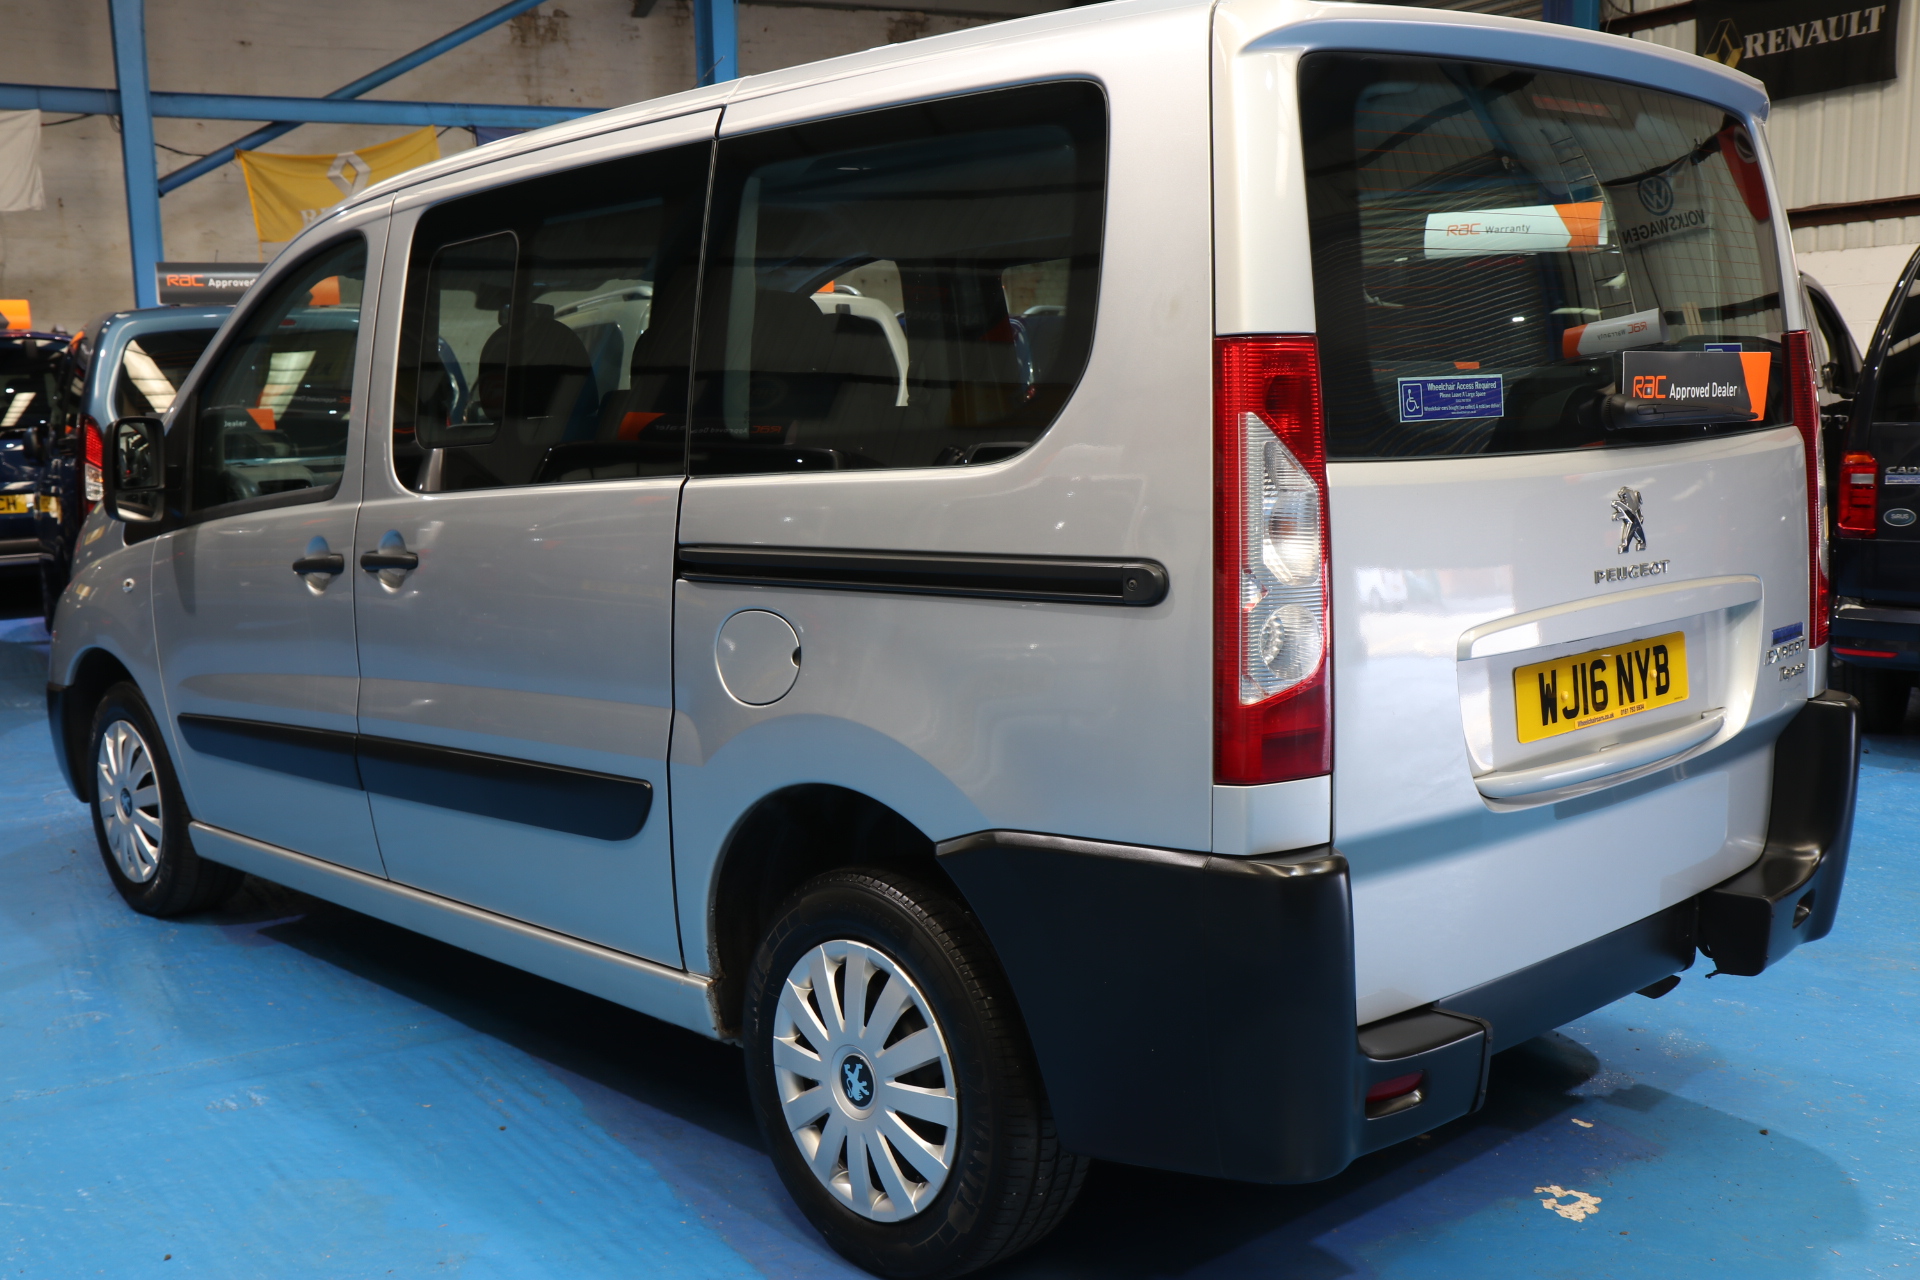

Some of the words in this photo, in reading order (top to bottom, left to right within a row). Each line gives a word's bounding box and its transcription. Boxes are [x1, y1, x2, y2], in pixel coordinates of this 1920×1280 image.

[1743, 5, 1886, 59] RENAULT
[1485, 224, 1531, 234] Warranty
[1427, 382, 1456, 391] Wheelchair
[1457, 382, 1474, 390] Access
[1475, 381, 1497, 390] Required
[1669, 382, 1710, 401] Approved
[1712, 382, 1738, 397] Dealer
[1594, 559, 1670, 584] PEUGEOT
[1763, 638, 1805, 666] EXPERT
[1538, 658, 1608, 726] WJ16
[1615, 644, 1670, 707] NYB
